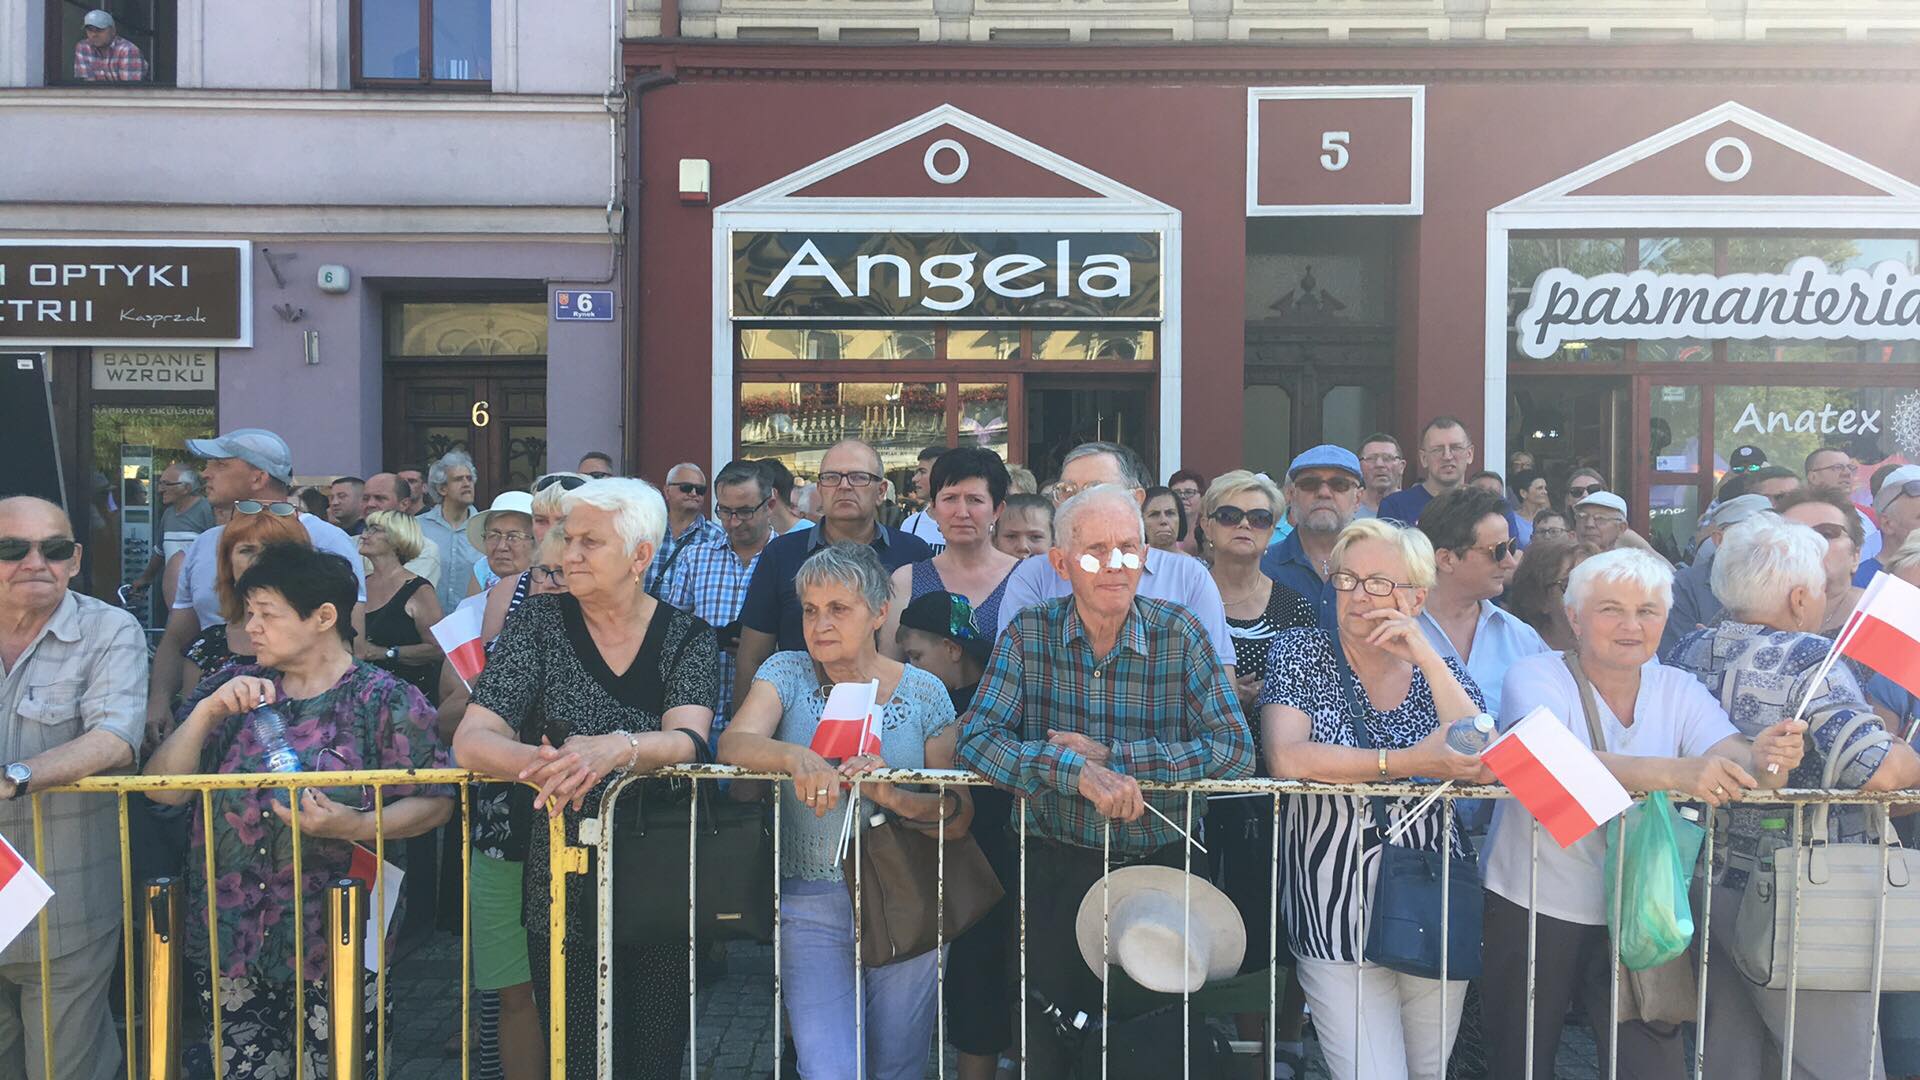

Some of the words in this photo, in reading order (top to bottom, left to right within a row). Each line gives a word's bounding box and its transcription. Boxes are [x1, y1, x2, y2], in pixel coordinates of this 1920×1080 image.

[1320, 131, 1350, 171] 5
[29, 264, 188, 287] OPTYKI
[324, 271, 333, 283] 6
[763, 239, 1131, 311] Angela
[0, 300, 92, 321] TRII
[120, 307, 206, 328] Kasprzak
[577, 293, 592, 312] 6
[104, 353, 206, 366] BADANIE
[106, 369, 204, 382] WZROKU
[472, 401, 489, 426] 6
[1733, 403, 1881, 435] Anatex
